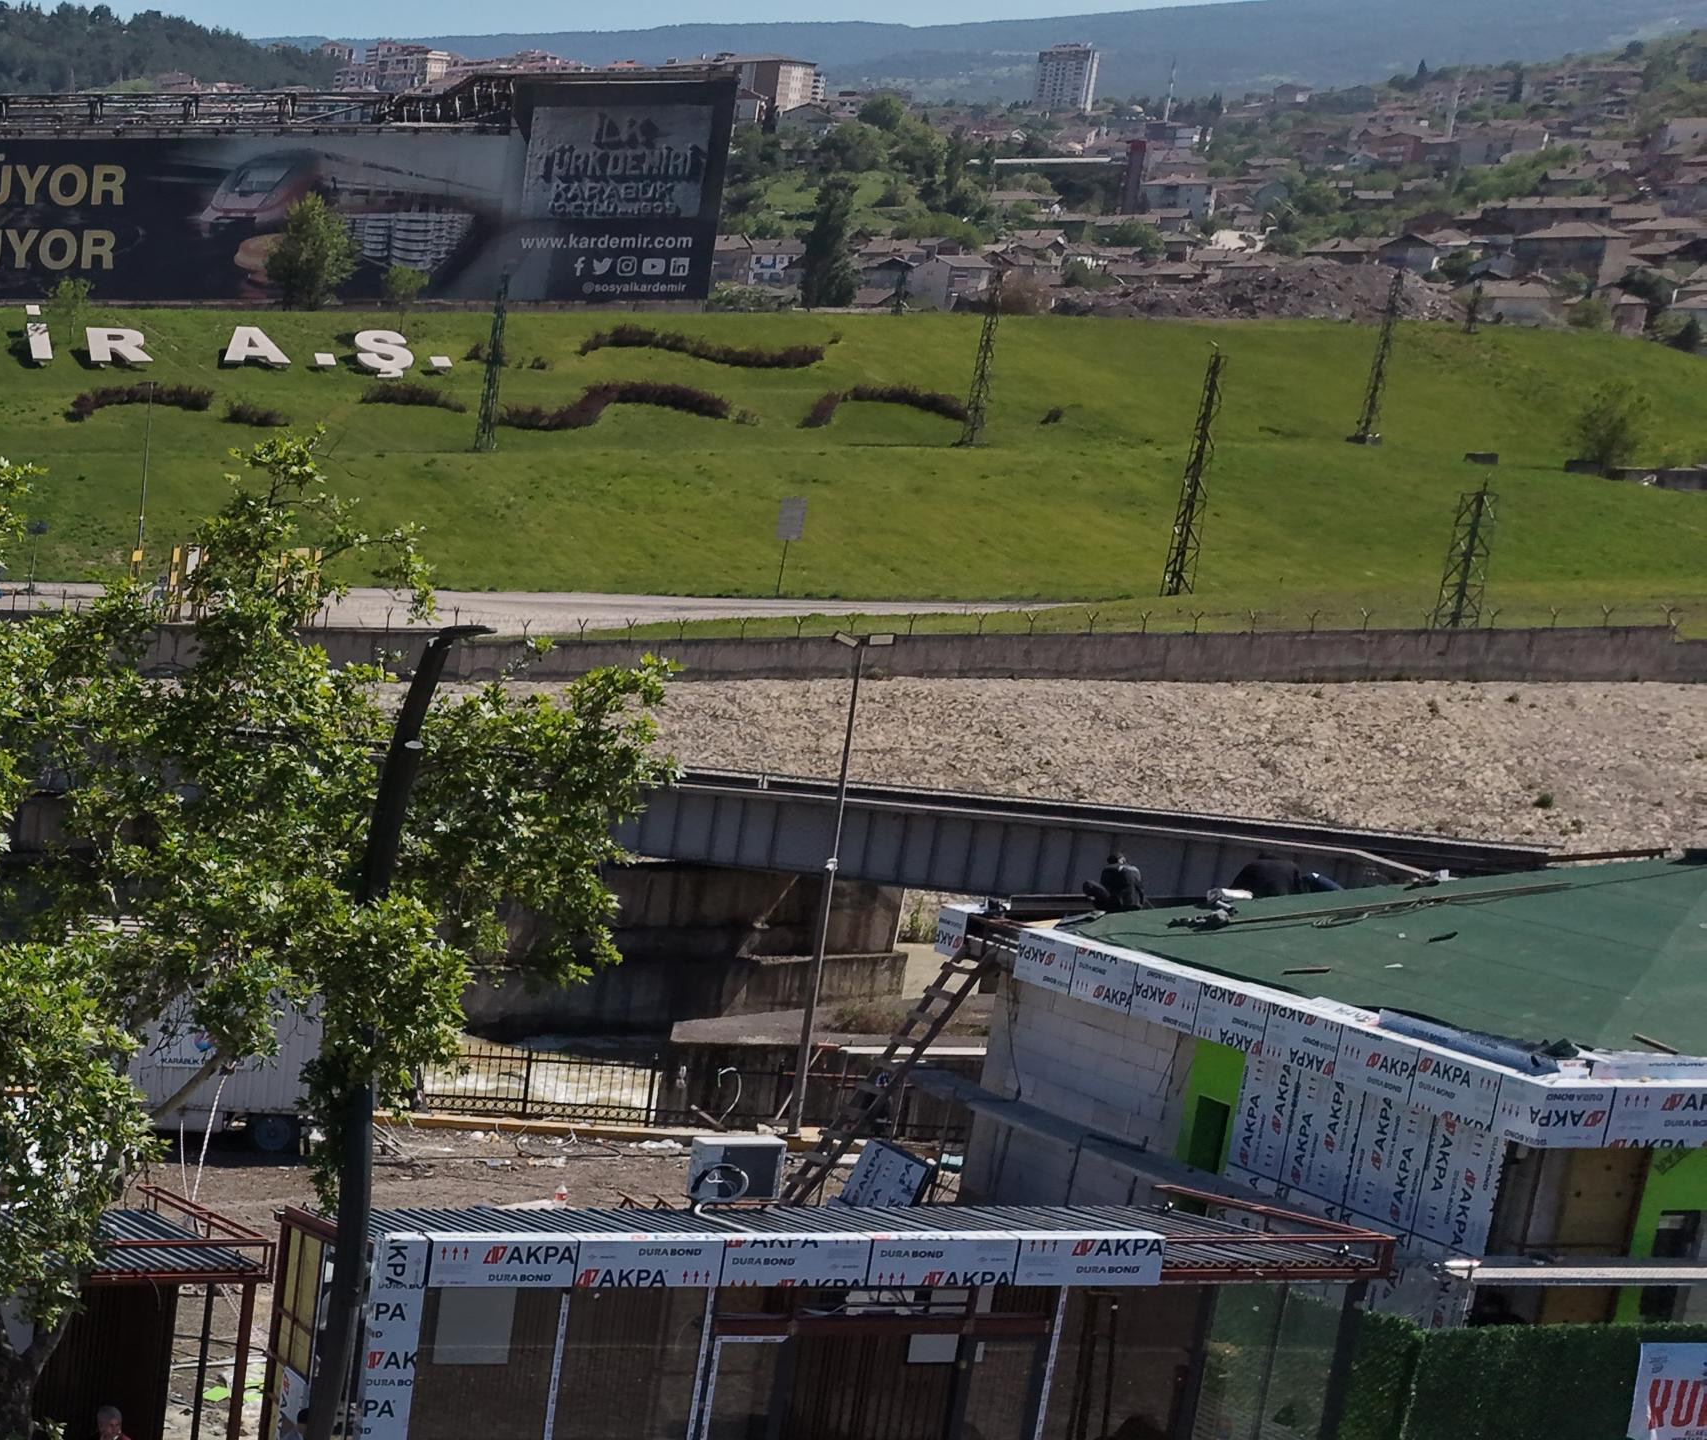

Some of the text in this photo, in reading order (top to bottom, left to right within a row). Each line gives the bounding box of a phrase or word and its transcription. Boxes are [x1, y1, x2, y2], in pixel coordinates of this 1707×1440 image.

[521, 234, 693, 250] www.kardemir.com
[582, 281, 687, 295] @sosyalkardemir
[1289, 1047, 1326, 1073] AKPA
[1379, 1056, 1417, 1080] AKPA
[1430, 1061, 1472, 1089] AKPA
[1244, 1093, 1261, 1150] AKPA
[1530, 1105, 1585, 1128] AKPA
[1293, 1112, 1314, 1170] AKPA
[1431, 1133, 1454, 1192] AKPA
[1394, 1147, 1415, 1205] AKPA
[1451, 1187, 1474, 1248] AKPA
[506, 1245, 575, 1265] AKPA
[1095, 1239, 1165, 1258] AKPA
[597, 1269, 667, 1288] AKPA
[939, 1271, 1012, 1287] AKPA
